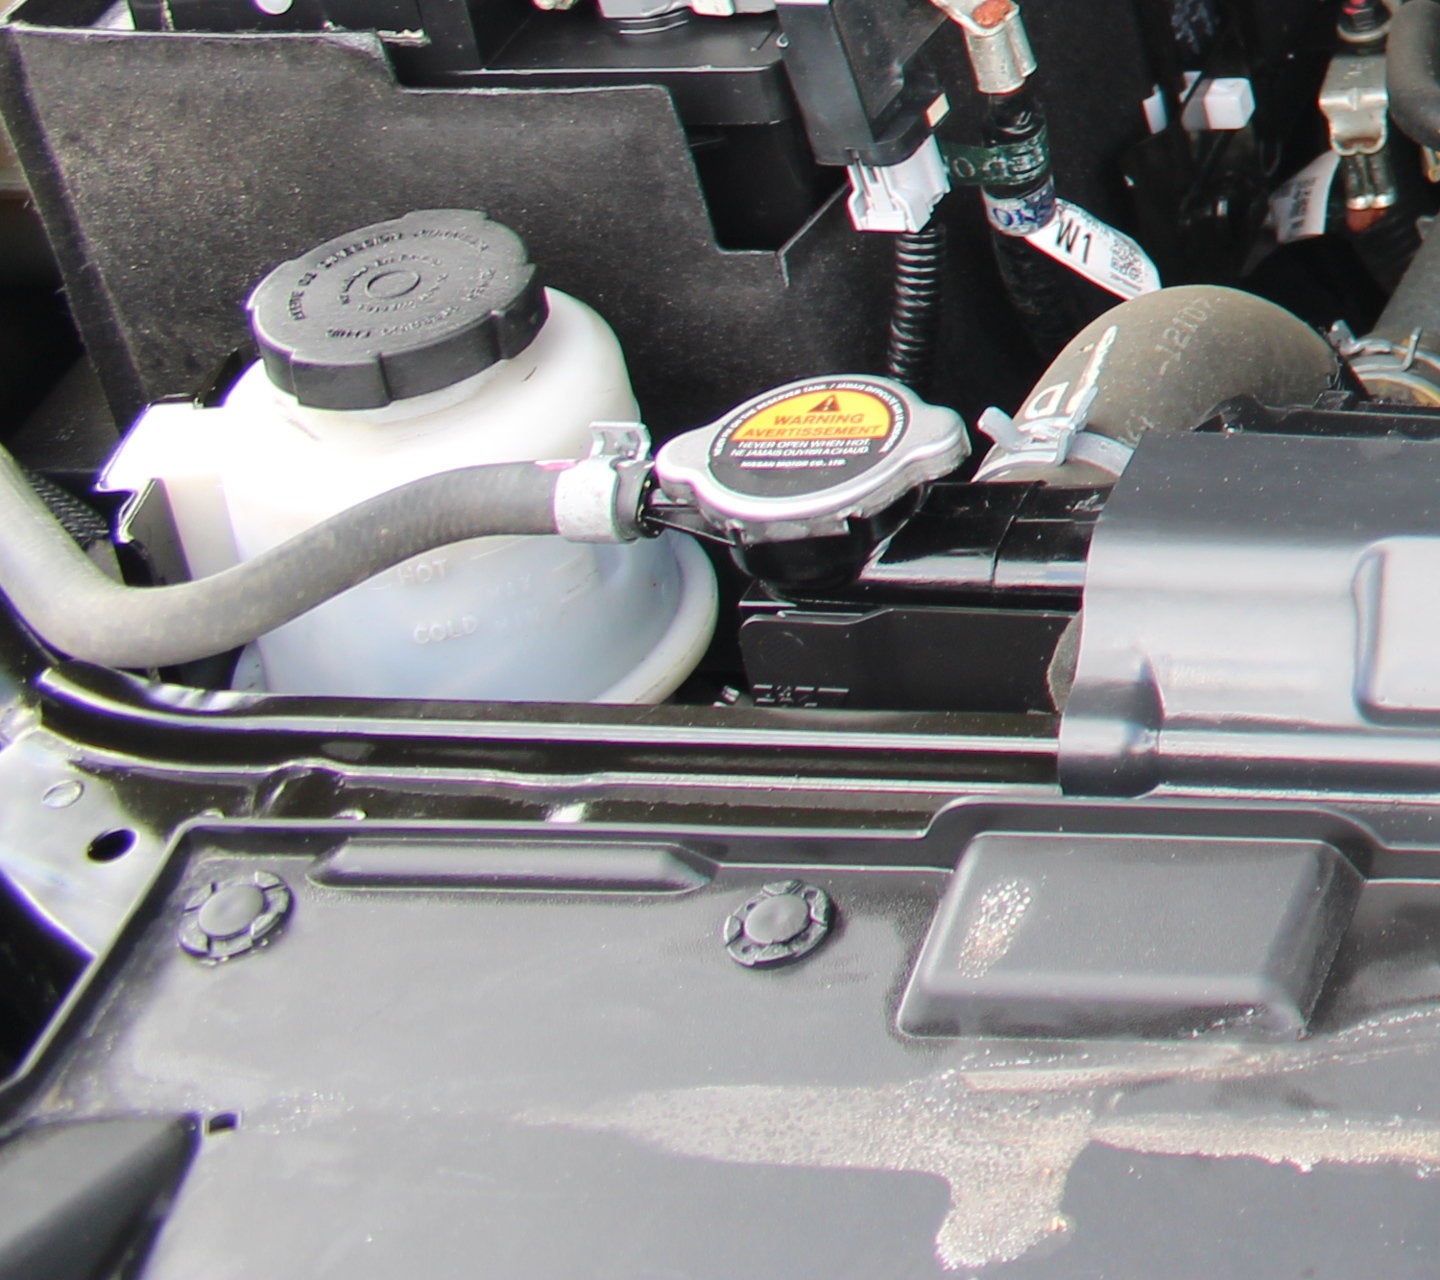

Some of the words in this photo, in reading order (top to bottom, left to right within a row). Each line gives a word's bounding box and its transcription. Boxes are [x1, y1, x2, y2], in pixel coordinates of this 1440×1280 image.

[1055, 216, 1092, 264] W1
[774, 414, 865, 426] WARNING
[742, 425, 884, 438] AVERTISSEMENT
[738, 440, 776, 449] NEVER
[777, 440, 810, 448] OPEN
[810, 439, 845, 448] WHEN
[730, 448, 745, 457] NE
[745, 448, 782, 457] JAMAIS
[412, 613, 480, 645] COLD
